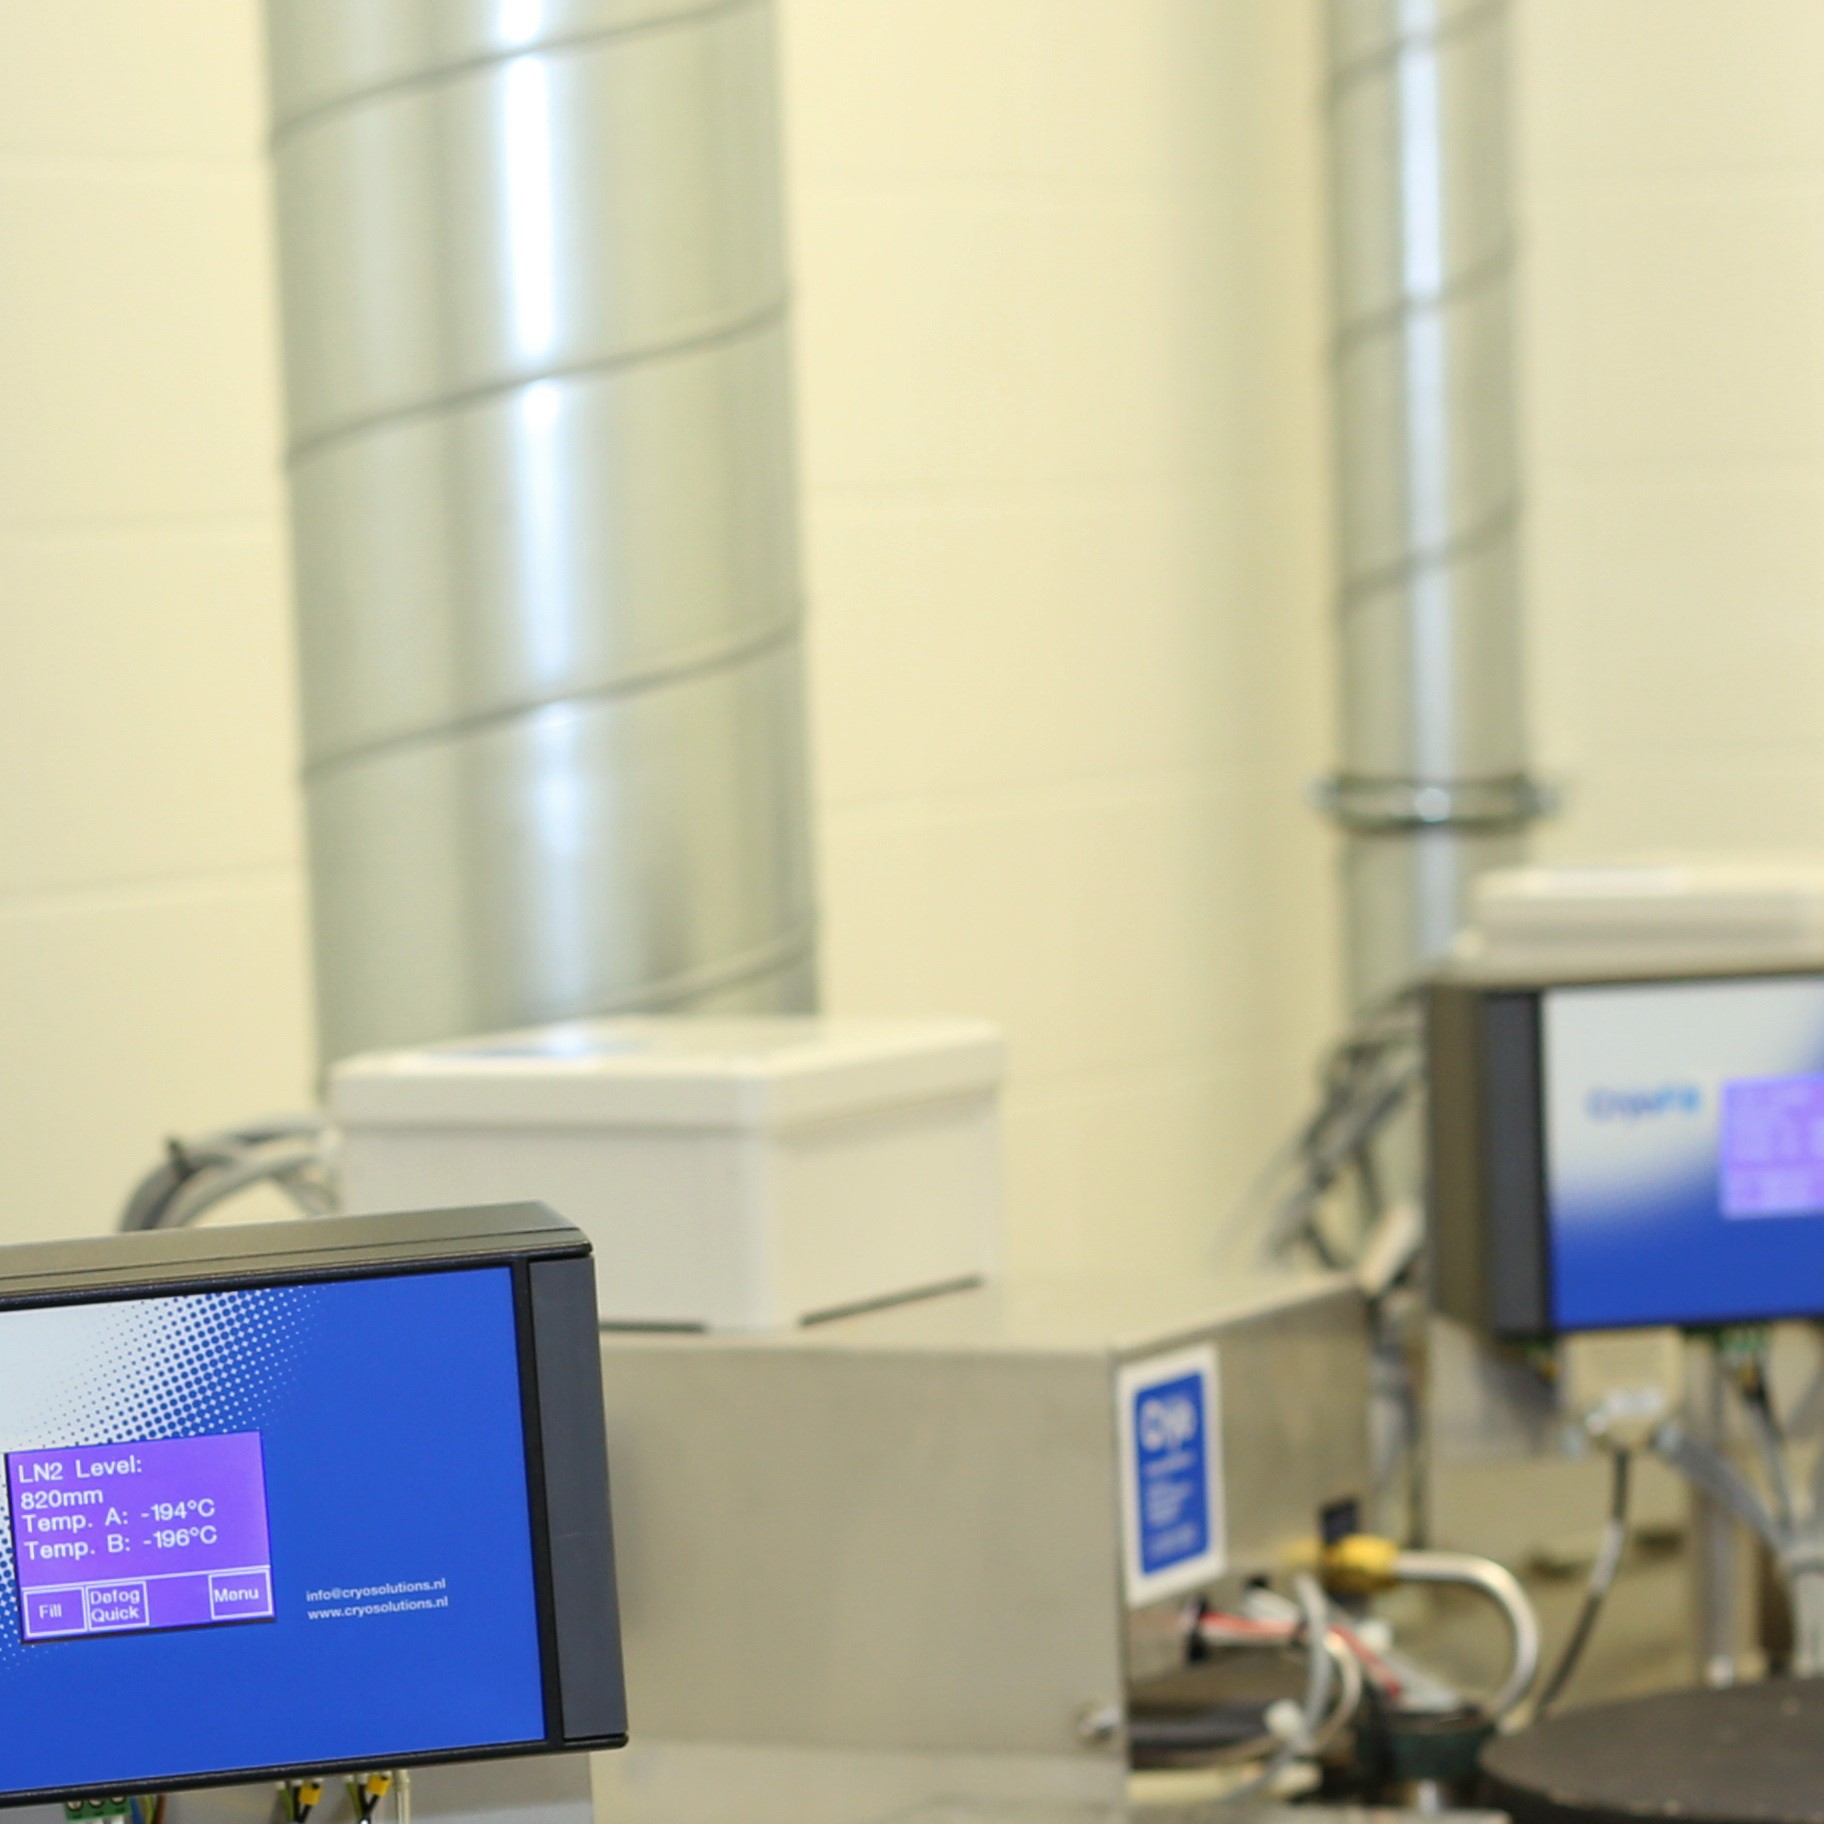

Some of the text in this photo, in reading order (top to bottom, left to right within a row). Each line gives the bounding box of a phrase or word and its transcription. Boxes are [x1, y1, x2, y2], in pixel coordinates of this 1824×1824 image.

[18, 1455, 142, 1484] LN2 Level:
[20, 1489, 104, 1510] 820mm
[21, 1498, 216, 1534] Temp. A: -194°C
[23, 1525, 218, 1560] Temp. B: -196°C
[90, 1589, 141, 1606] Defog
[213, 1587, 259, 1604] Menu
[306, 1578, 447, 1603] info@cryosolutions.nl
[38, 1602, 63, 1619] Fill
[90, 1605, 140, 1624] Quick
[307, 1596, 449, 1620] www.cryosolutions.nl
